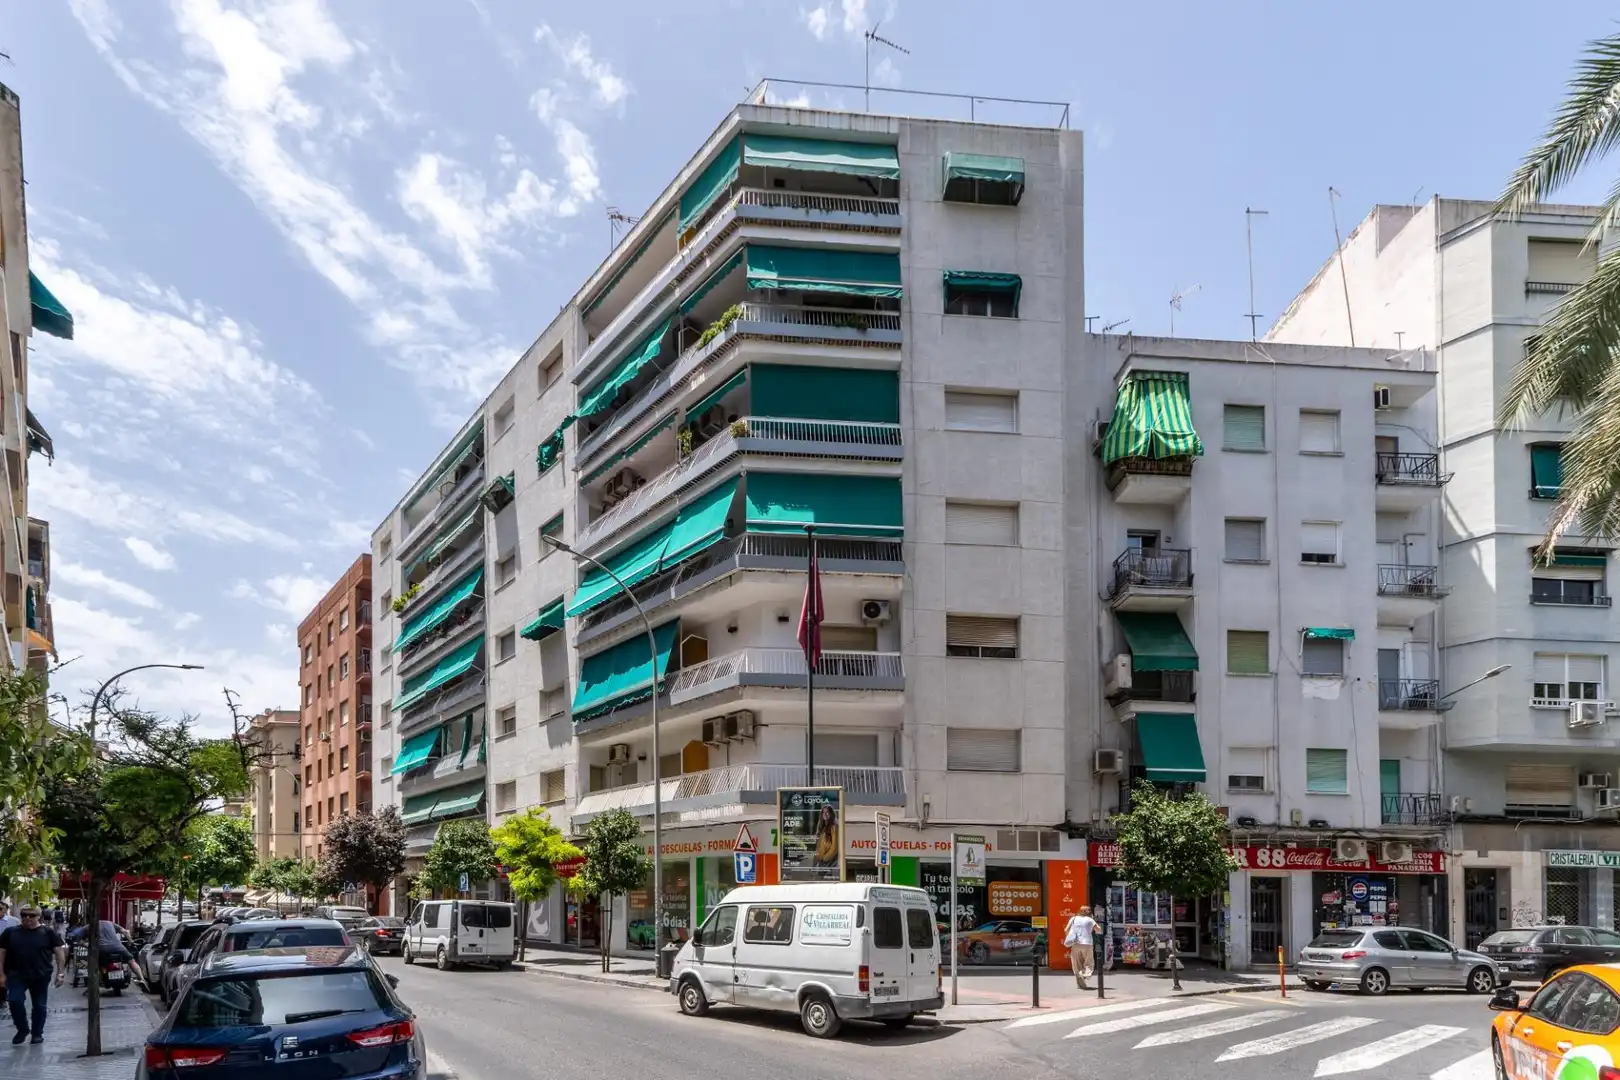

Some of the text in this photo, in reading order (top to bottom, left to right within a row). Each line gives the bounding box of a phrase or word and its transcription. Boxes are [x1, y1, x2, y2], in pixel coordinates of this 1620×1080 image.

[784, 820, 800, 828] ADE
[1256, 849, 1286, 868] 88
[1550, 852, 1595, 866] CRISTALERIA
[740, 856, 753, 880] P
[264, 1050, 319, 1061] LEON
